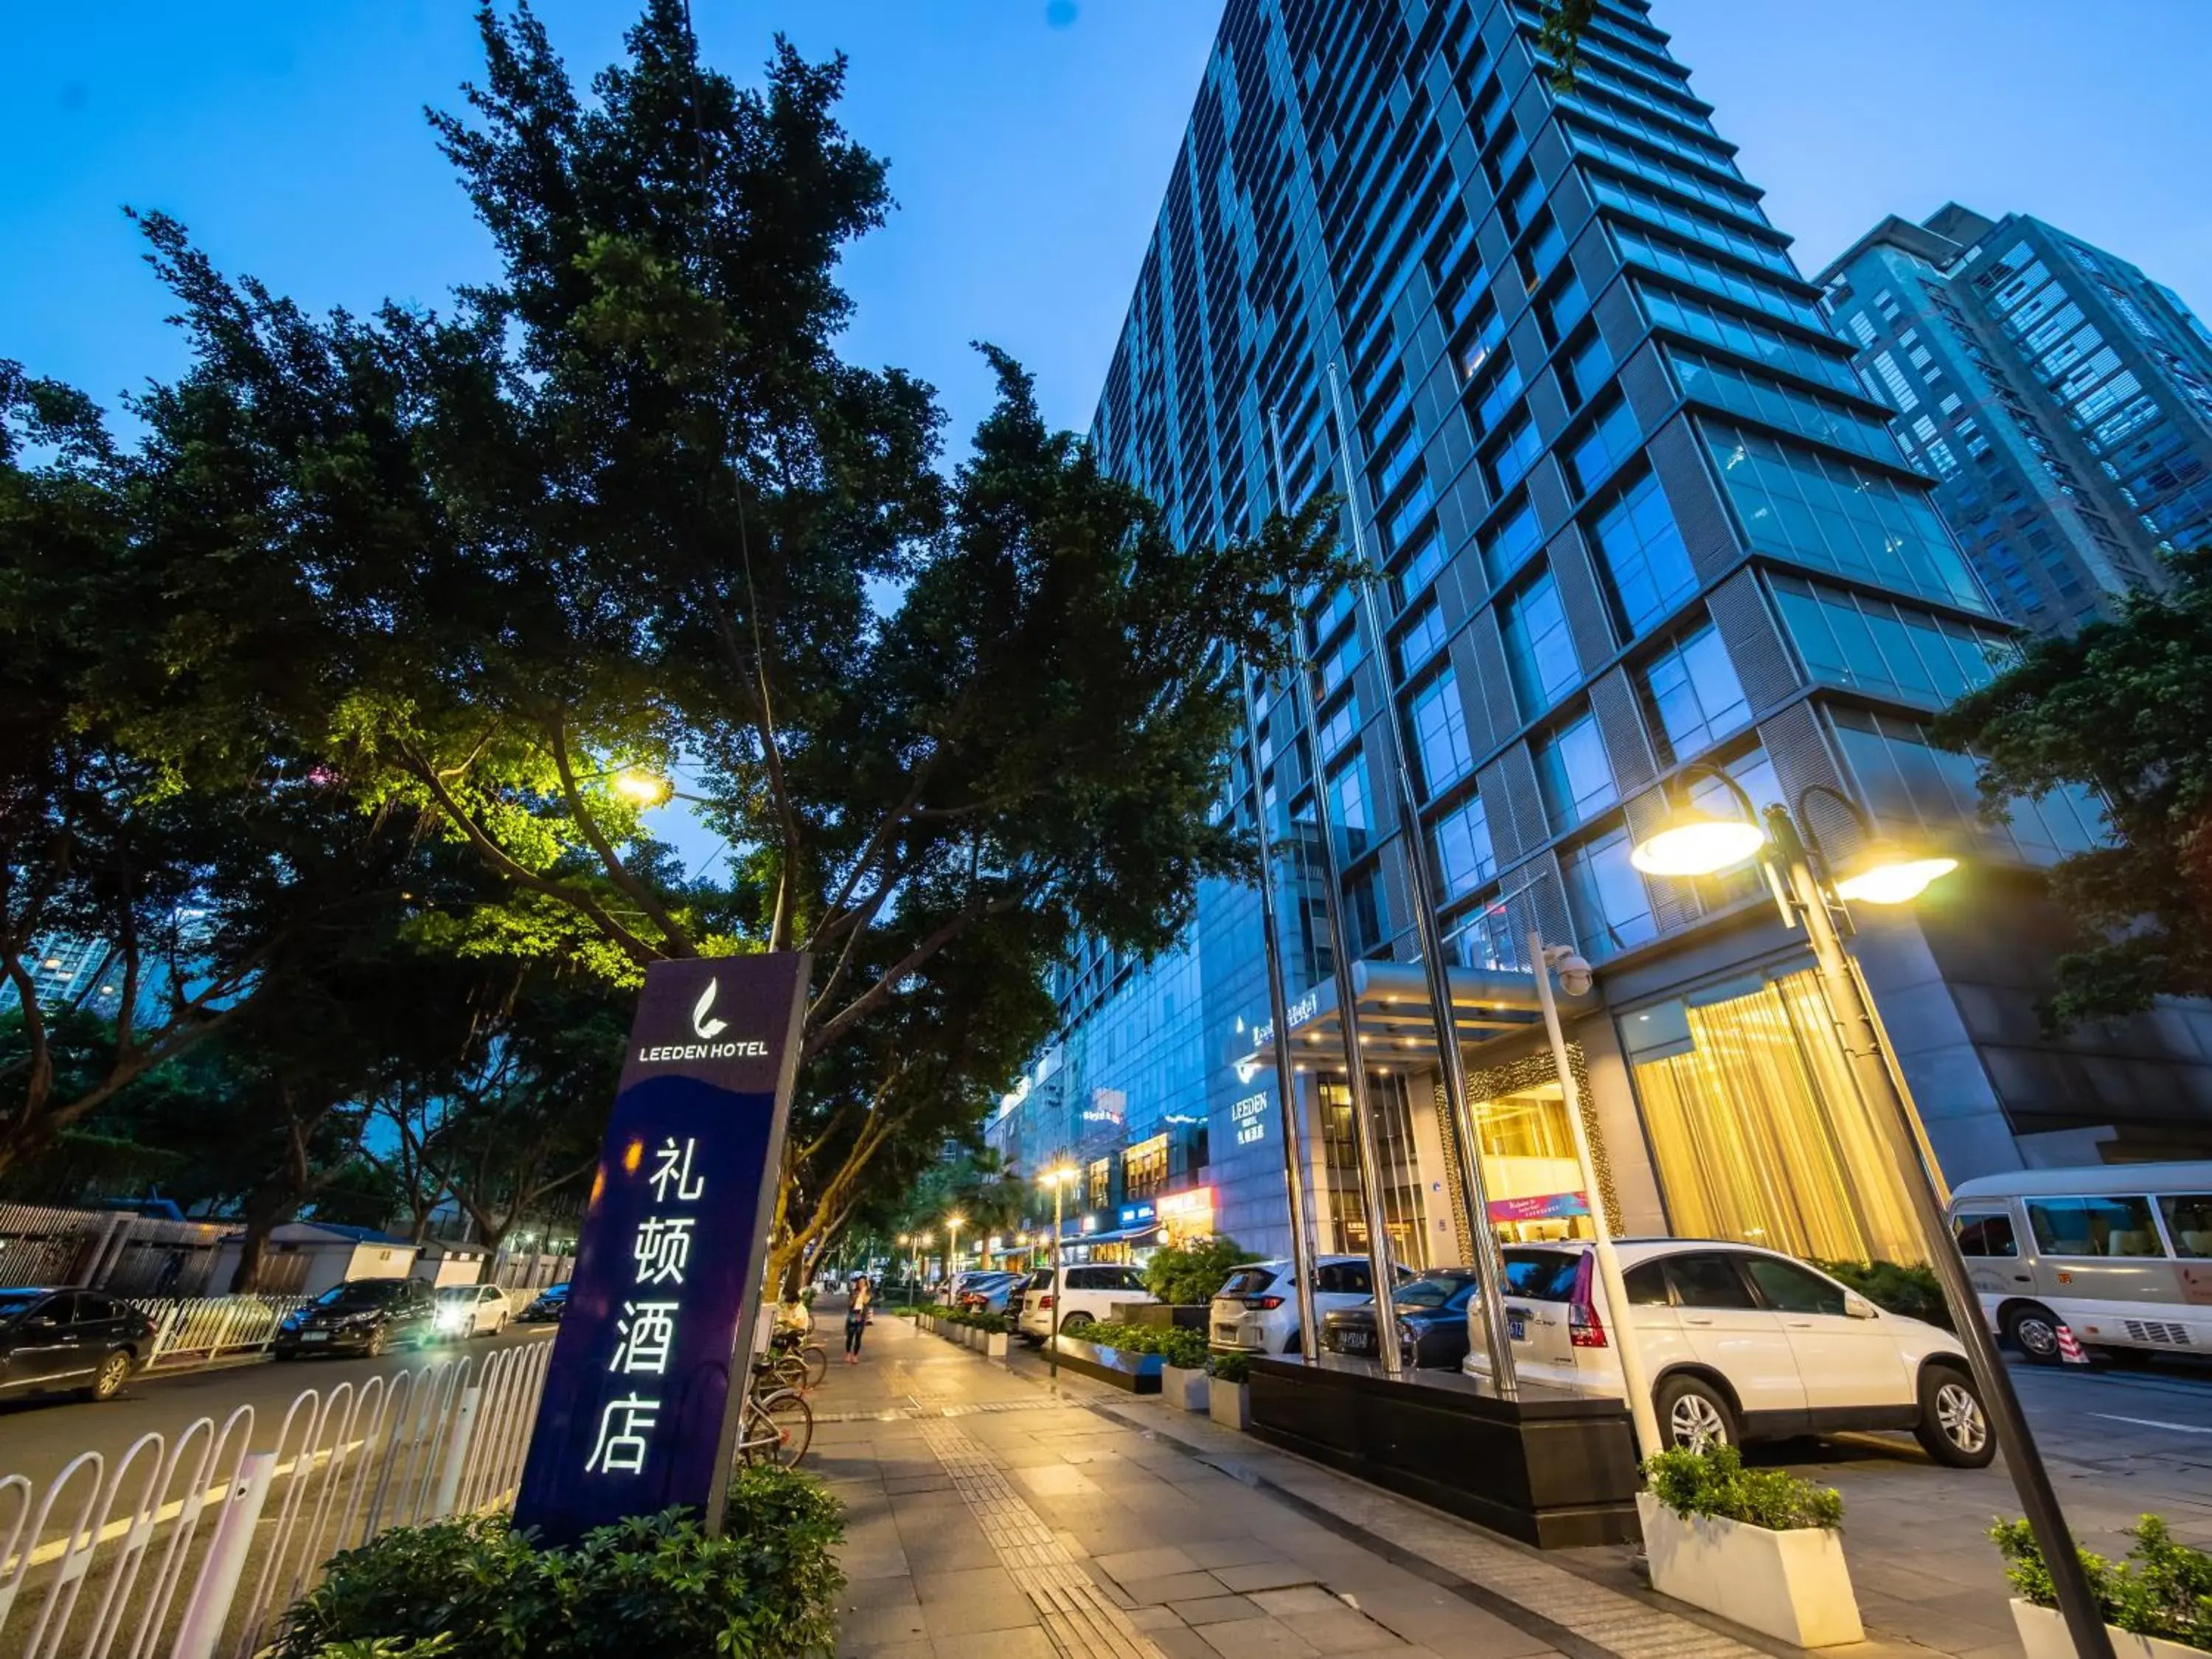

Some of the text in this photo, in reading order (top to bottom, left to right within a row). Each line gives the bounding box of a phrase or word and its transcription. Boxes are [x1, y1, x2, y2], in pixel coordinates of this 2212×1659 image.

[639, 1041, 769, 1062] LEEDEN HOTEL
[1232, 1091, 1267, 1121] LEEDEN
[585, 1136, 705, 1475] 礼顿酒店
